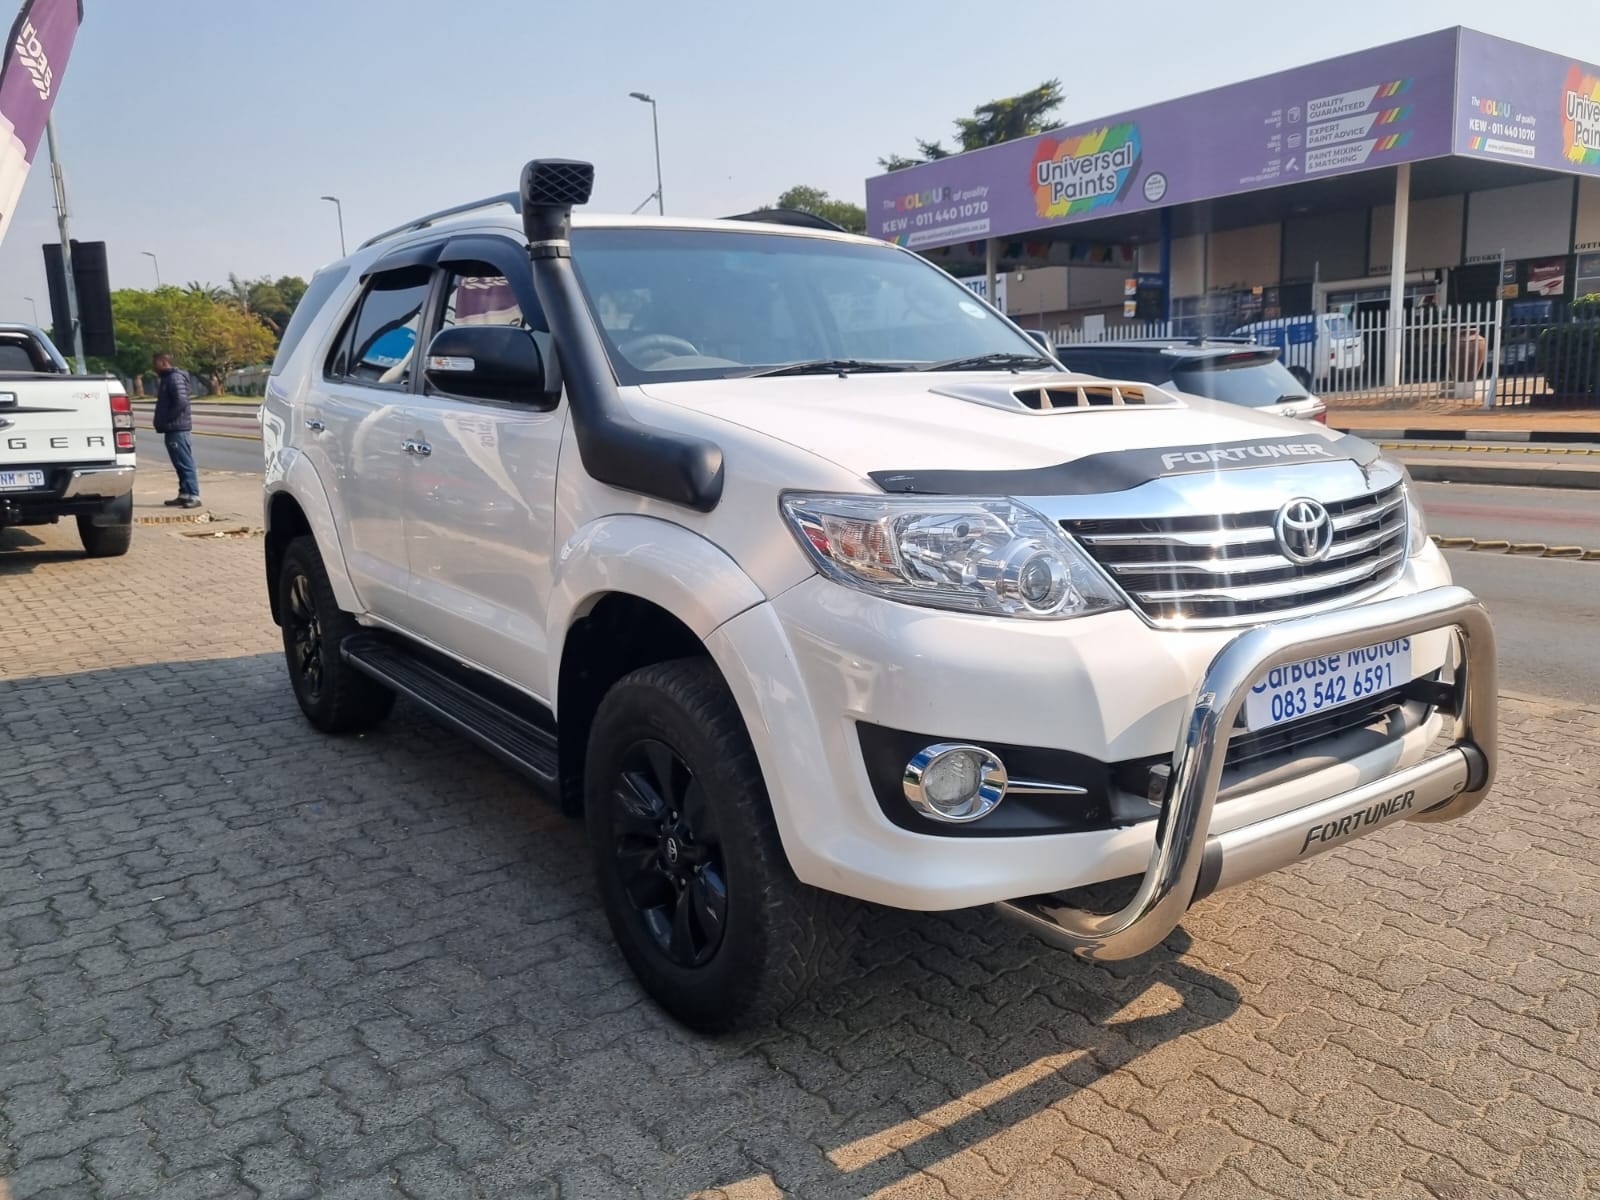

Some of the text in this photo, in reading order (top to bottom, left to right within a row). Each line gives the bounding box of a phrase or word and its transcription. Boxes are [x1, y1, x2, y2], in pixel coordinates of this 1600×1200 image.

[1309, 101, 1365, 119] GUARANTEED
[1310, 97, 1344, 111] QUALITY
[1309, 124, 1339, 136] EXPERT
[1309, 127, 1365, 144] PAINT ADVICE
[1469, 119, 1487, 132] KEW
[1492, 124, 1503, 135] 011
[1504, 126, 1518, 138] 440
[1518, 127, 1535, 141] 1070
[1308, 145, 1362, 161] PAINT MIXING
[1314, 155, 1357, 168] MATCHING
[1039, 144, 1131, 183] Universal
[1054, 172, 1115, 202] Paints
[882, 218, 908, 234] KEW
[916, 212, 933, 226] 011
[935, 207, 957, 221] 440
[959, 201, 989, 217] 1070
[7, 436, 105, 450] GER
[1161, 443, 1335, 471] FORTUNER
[27, 472, 42, 483] GP
[1271, 662, 1392, 721] 083 542 6591
[1299, 789, 1415, 856] FORTUNER
